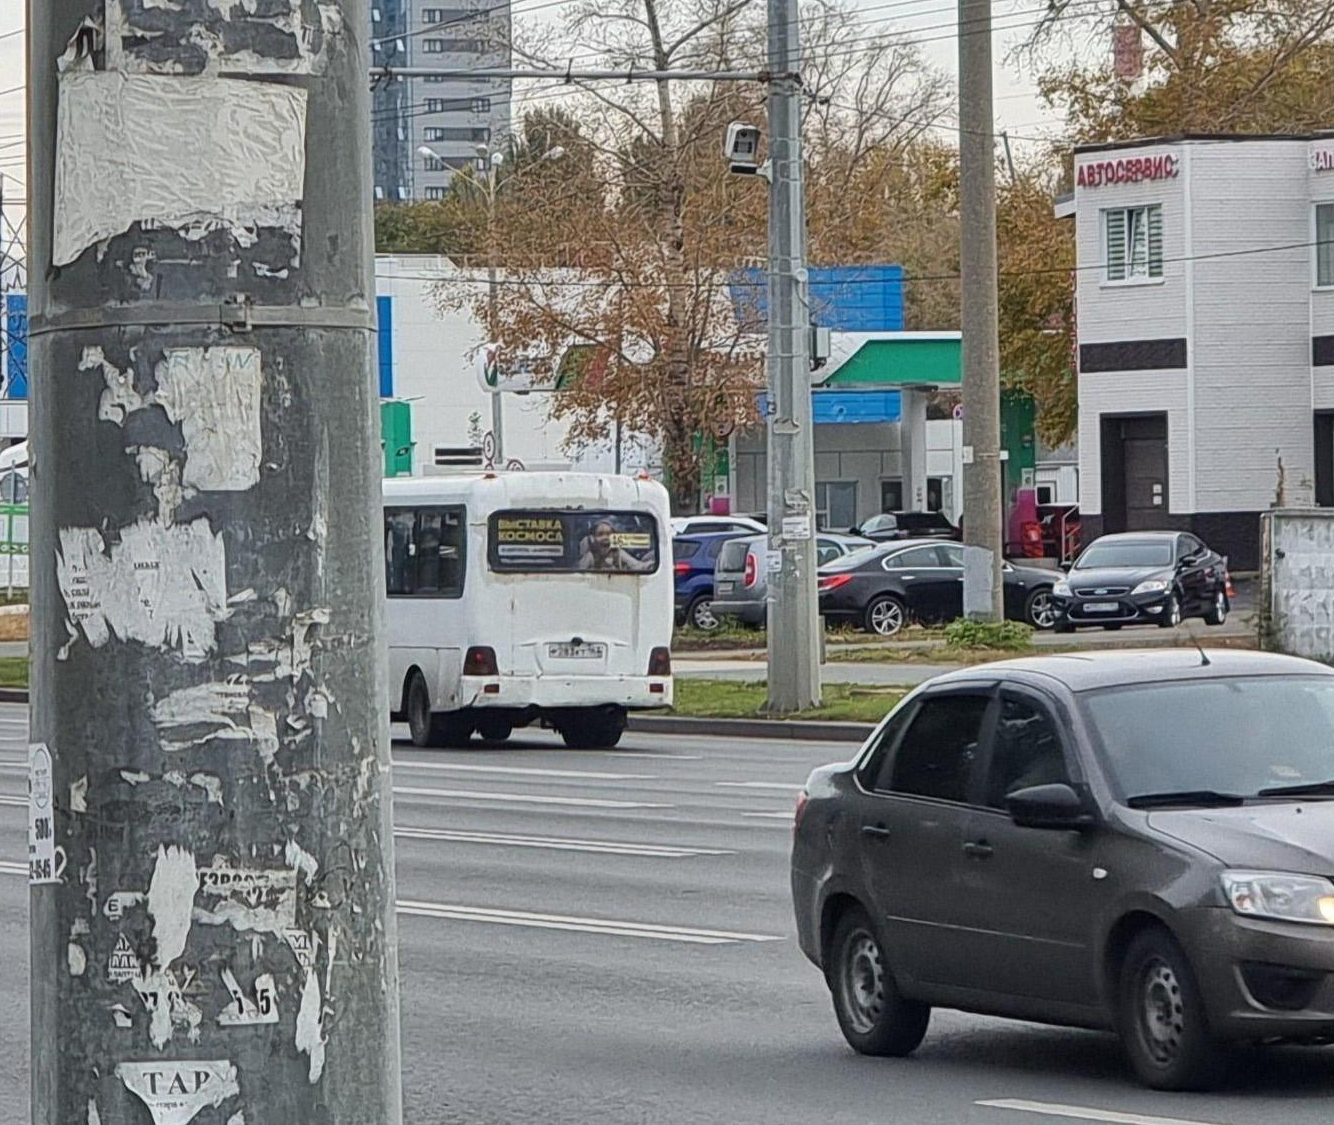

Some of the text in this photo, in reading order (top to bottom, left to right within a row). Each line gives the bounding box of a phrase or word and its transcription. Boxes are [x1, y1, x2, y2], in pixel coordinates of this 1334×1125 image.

[1077, 154, 1179, 187] АВТОСЕРВИС
[498, 519, 562, 530] ВЫСТАВКА
[498, 531, 563, 542] КОСМОСА
